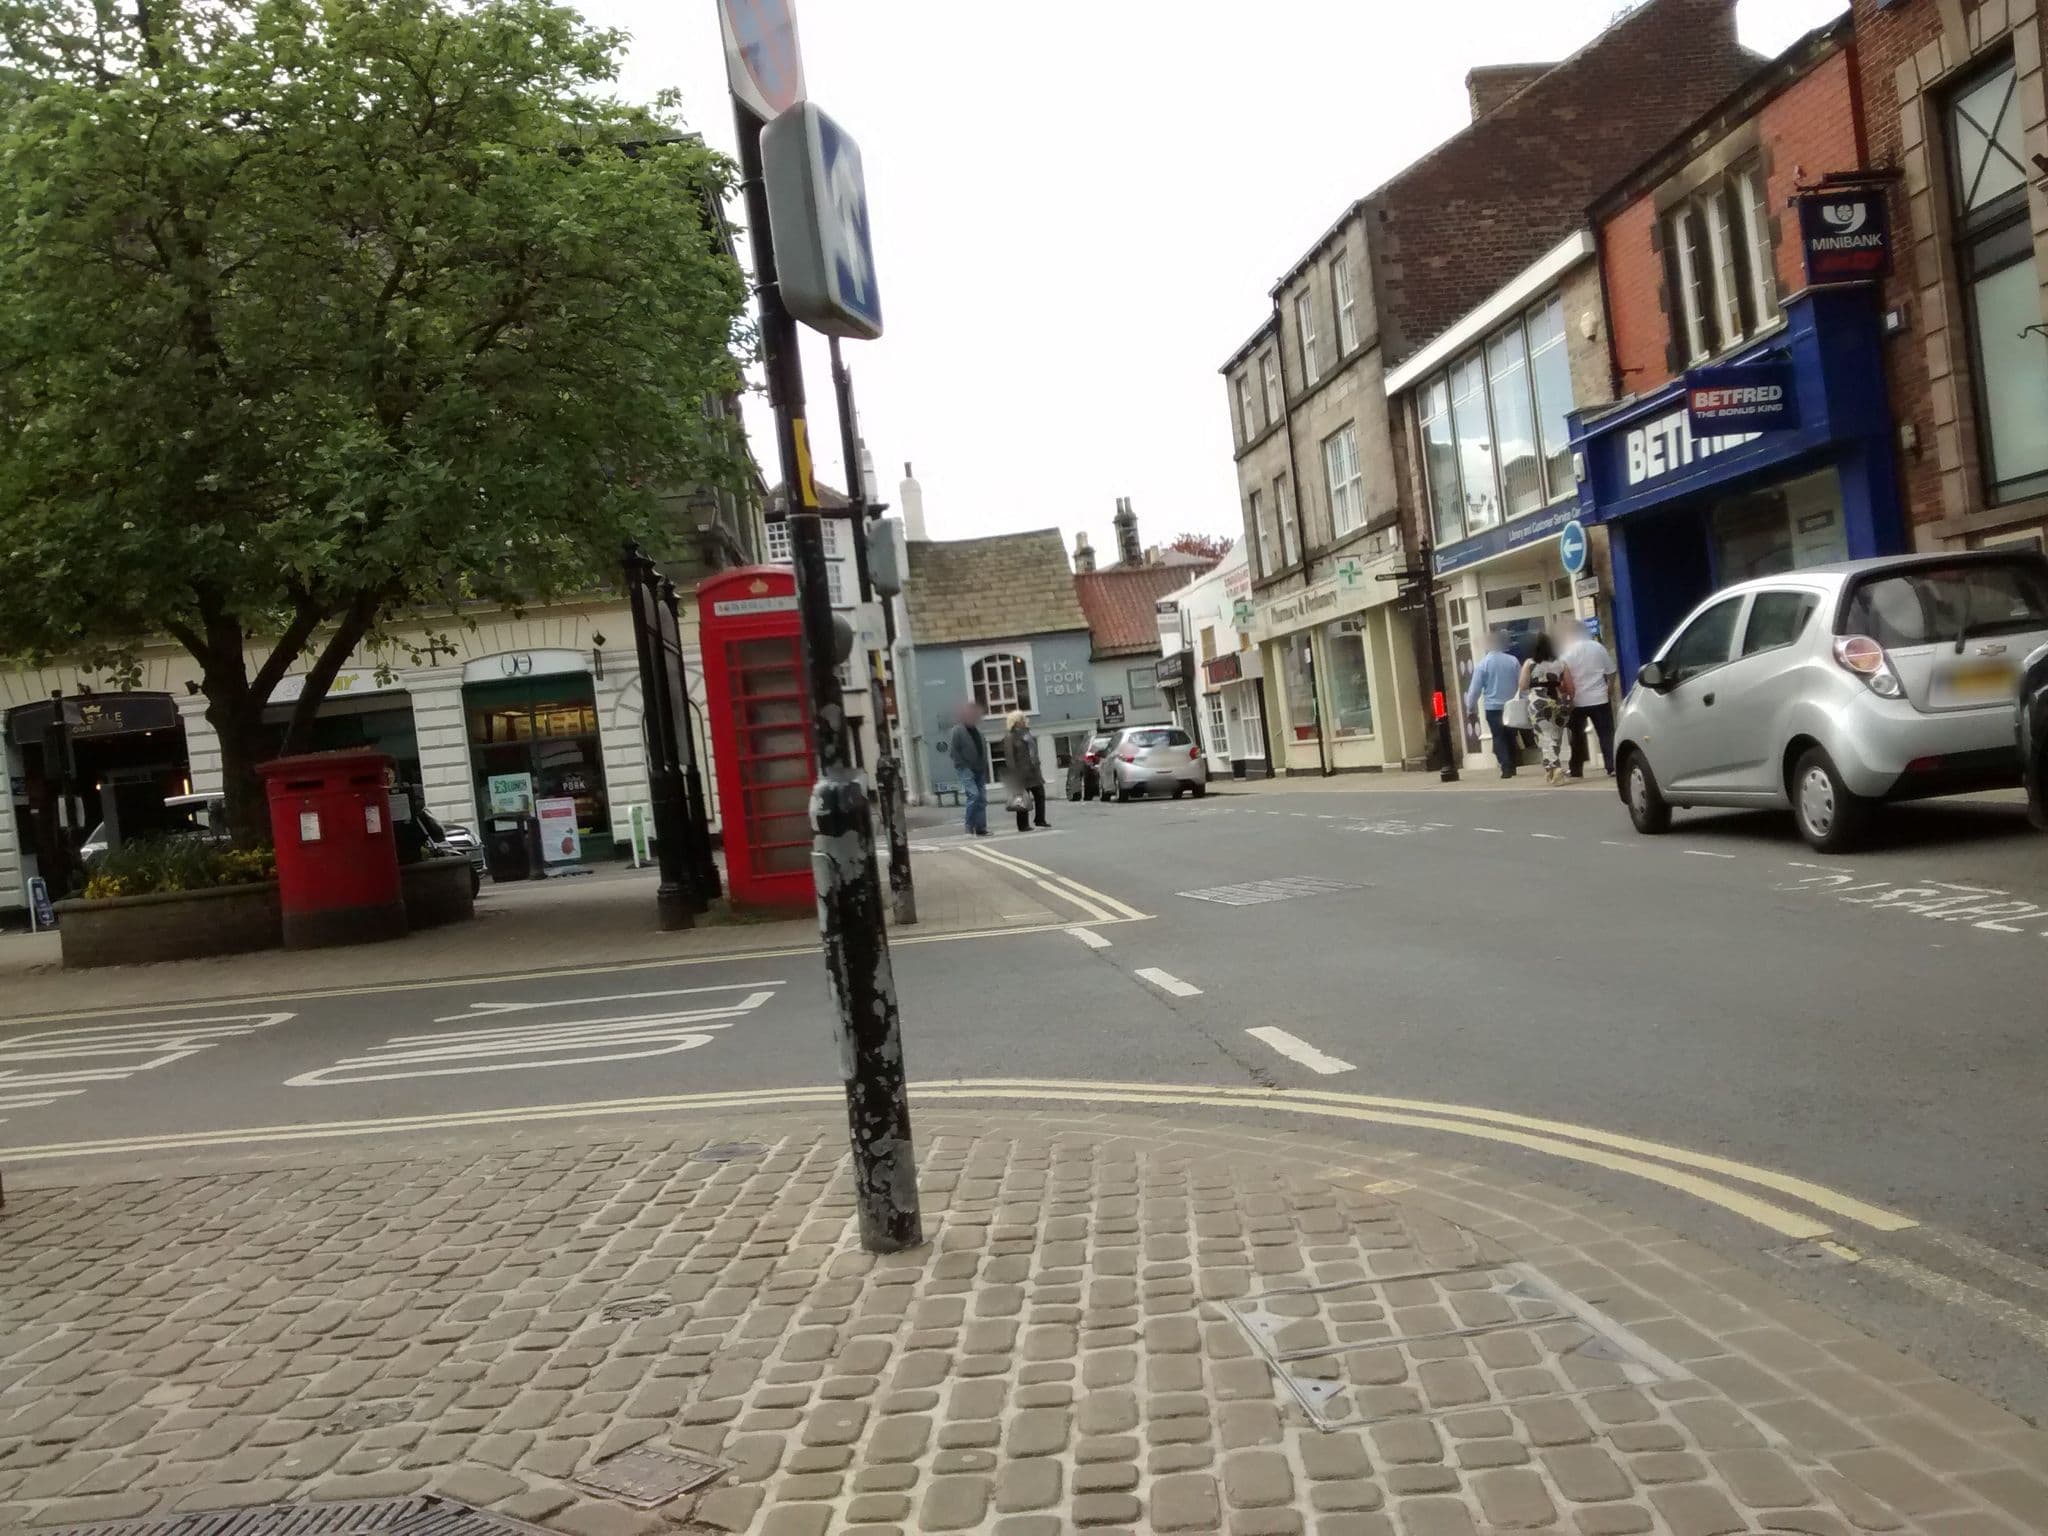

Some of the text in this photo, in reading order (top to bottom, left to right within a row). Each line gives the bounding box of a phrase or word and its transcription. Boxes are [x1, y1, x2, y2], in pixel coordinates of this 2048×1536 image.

[1811, 233, 1884, 251] MINIBANK
[1694, 384, 1783, 409] BETFRED
[1696, 402, 1783, 419] THE BONUS KING
[1627, 407, 1764, 486] BETF
[1043, 659, 1069, 673] SIX
[1043, 671, 1084, 684] POOR
